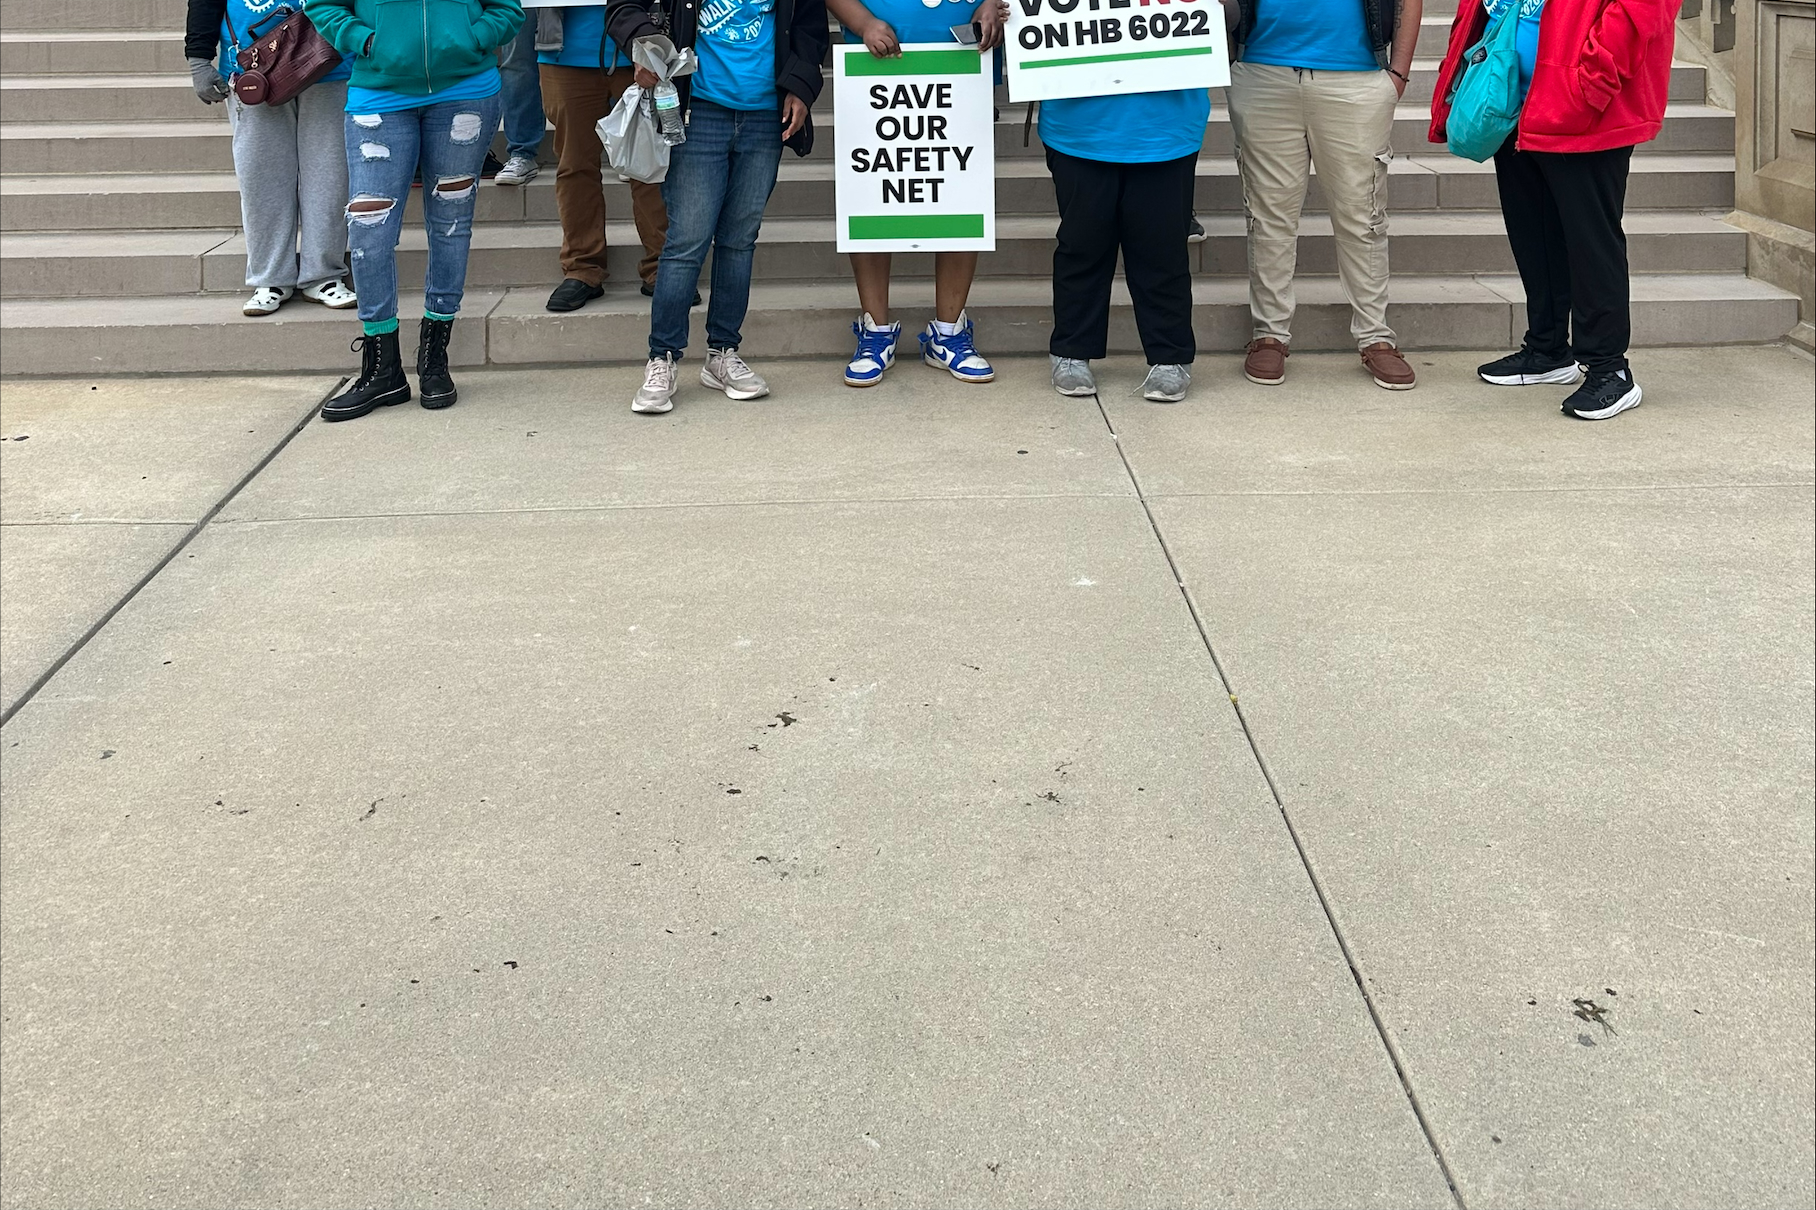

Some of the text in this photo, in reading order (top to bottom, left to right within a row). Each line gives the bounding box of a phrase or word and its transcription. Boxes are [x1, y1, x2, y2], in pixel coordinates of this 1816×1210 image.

[744, 21, 761, 41] 202
[1018, 10, 1210, 50] ON HB 6022
[869, 83, 952, 110] SAVE
[875, 115, 948, 141] OUR
[851, 146, 974, 173] SAFETY
[882, 178, 945, 204] NET
